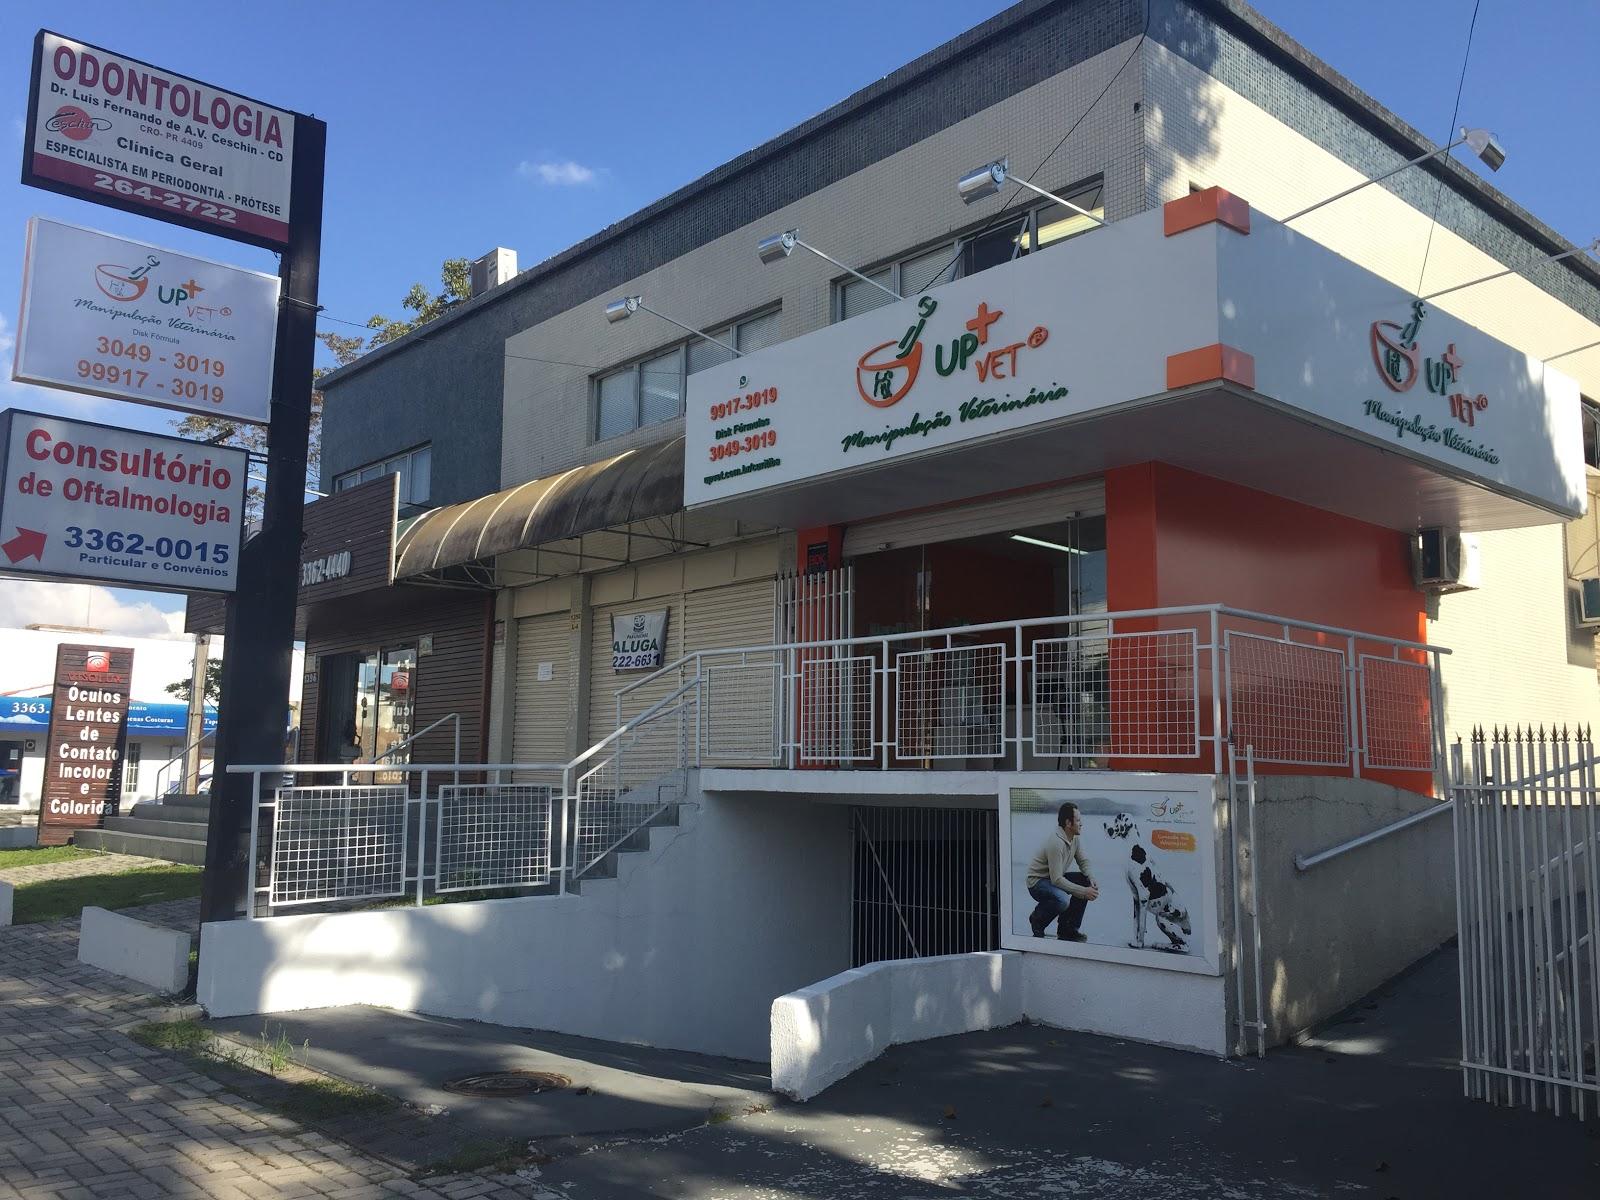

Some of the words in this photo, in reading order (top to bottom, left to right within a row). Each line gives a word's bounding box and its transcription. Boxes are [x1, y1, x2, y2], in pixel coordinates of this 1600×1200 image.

[53, 45, 283, 149] ODONTOLOGIA
[51, 82, 67, 96] Dr.
[73, 89, 99, 106] Luis
[104, 99, 162, 126] Fernando
[166, 115, 180, 131] de
[185, 124, 207, 140] A.V.
[212, 133, 257, 156] Ceschin
[268, 148, 283, 162] CD
[166, 130, 179, 143] PR
[46, 140, 128, 173] ESPECIALISTA
[132, 164, 148, 178] EM
[151, 170, 225, 201] PERIODONTIA
[180, 155, 223, 178] Geral
[94, 173, 237, 223] 264-2722
[73, 296, 162, 326] Manipulação
[168, 318, 236, 342] Veterinária
[133, 328, 149, 340] Disk
[150, 330, 180, 345] Fórmula
[96, 336, 151, 362] 3049
[174, 352, 225, 378] 3019
[77, 360, 149, 389] 99917
[171, 378, 224, 404] 3019
[710, 387, 778, 421] 9917-3019
[841, 411, 951, 453] Manipulação
[959, 382, 1069, 423] Veterinária
[710, 430, 777, 462] 3049-3019
[716, 427, 732, 440] Disk
[26, 429, 231, 490] Consultório
[18, 472, 53, 497] de
[63, 478, 230, 525] Oftalmologia
[64, 526, 229, 564] 3362-0015
[79, 552, 147, 569] Particular
[151, 561, 159, 570] e
[163, 562, 228, 577] Convênios
[613, 638, 658, 653] ALUGA
[68, 682, 120, 704] Óculos
[66, 706, 120, 723] Lentes
[80, 726, 99, 741] de
[60, 743, 119, 761] Contato
[60, 763, 112, 780] Incolor
[81, 783, 90, 795] e
[50, 799, 113, 815] Colorida
